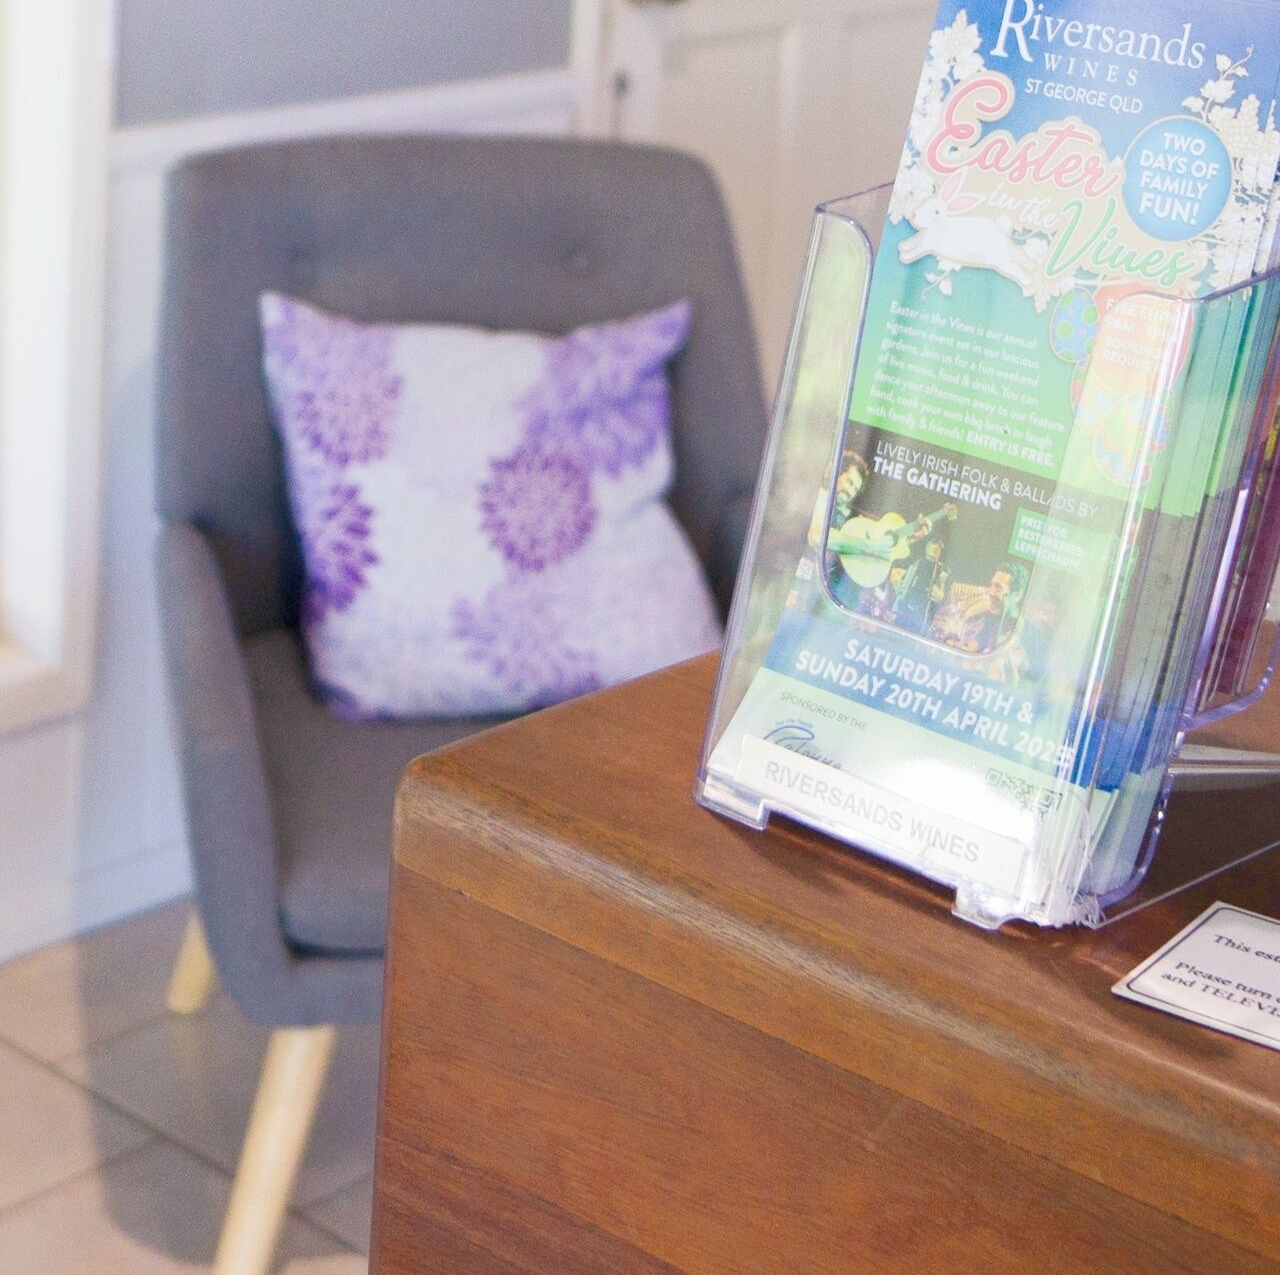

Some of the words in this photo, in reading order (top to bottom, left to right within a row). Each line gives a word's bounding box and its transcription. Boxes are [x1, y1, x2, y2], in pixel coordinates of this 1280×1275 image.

[1043, 53, 1139, 86] WINES
[1025, 78, 1044, 95] ST
[1043, 82, 1107, 108] GEORGE
[1109, 97, 1143, 114] QLD
[926, 77, 1120, 198] Easter
[1163, 132, 1205, 155] TWO
[1140, 150, 1191, 174] DAYS
[1195, 162, 1220, 181] OF
[1140, 171, 1210, 199] FAMILY
[1020, 197, 1060, 228] the
[1139, 192, 1200, 225] FUN!
[1046, 195, 1197, 289] Vines
[886, 320, 927, 339] signature
[928, 332, 955, 347] event
[956, 340, 970, 351] set
[972, 341, 982, 353] in
[983, 347, 1000, 359] our
[1001, 348, 1040, 370] luscious
[890, 301, 920, 317] Easter
[920, 309, 929, 322] in
[931, 312, 946, 326] the
[949, 315, 975, 333] Vines
[976, 324, 984, 336] is
[986, 330, 1002, 341] our
[1003, 335, 1037, 350] annual
[878, 353, 889, 365] of
[889, 354, 905, 369] live
[906, 362, 936, 379] music,
[938, 367, 961, 385] food
[961, 375, 970, 387] &
[1002, 385, 1019, 402] You
[1020, 394, 1039, 406] can
[881, 338, 919, 355] gardens.
[920, 345, 940, 361] Join
[942, 355, 953, 365] us
[954, 354, 969, 368] for
[970, 362, 976, 371] a
[978, 360, 994, 376] fun
[996, 369, 1040, 388] weekend
[870, 384, 895, 404] band,
[897, 395, 920, 409] cook
[920, 403, 943, 416] your
[943, 410, 964, 422] own
[964, 414, 984, 432] bbq
[984, 418, 1011, 436] lunch
[1013, 429, 1026, 440] or
[1025, 428, 1053, 450] laugh
[874, 368, 901, 385] dance
[901, 379, 923, 391] your
[924, 383, 971, 406] afternoon
[972, 399, 996, 417] away
[998, 405, 1009, 417] to
[1010, 409, 1027, 421] our
[1029, 410, 1065, 433] feature
[866, 405, 887, 418] with
[888, 408, 917, 430] family
[920, 417, 928, 430] &
[928, 419, 964, 440] friends!
[966, 430, 1006, 453] ENTRY
[1007, 442, 1018, 456] IS
[1021, 445, 1055, 467] FREE.
[873, 456, 904, 481] THE
[907, 467, 1002, 511] GATHERING
[876, 440, 920, 463] LIVELY
[922, 455, 959, 476] IRISH
[961, 466, 997, 490] FOLK
[1000, 478, 1010, 494] &
[1012, 480, 1075, 513] BALLADS
[1076, 501, 1099, 518] BY
[795, 650, 887, 698] SUNDAY
[884, 683, 943, 720] 20TH
[942, 706, 1008, 747] APRIL
[843, 638, 960, 695] SATURDAY
[960, 681, 1014, 716] 19TH
[1017, 702, 1033, 724] &
[781, 691, 837, 719] SPONSORED
[836, 712, 850, 725] BY
[849, 716, 869, 732] THE
[764, 760, 903, 832] RIVERSANDS
[910, 817, 980, 864] WINES
[1213, 933, 1252, 953] This
[1160, 971, 1197, 989] and
[1175, 961, 1233, 986] Please
[1235, 982, 1273, 1000] turn
